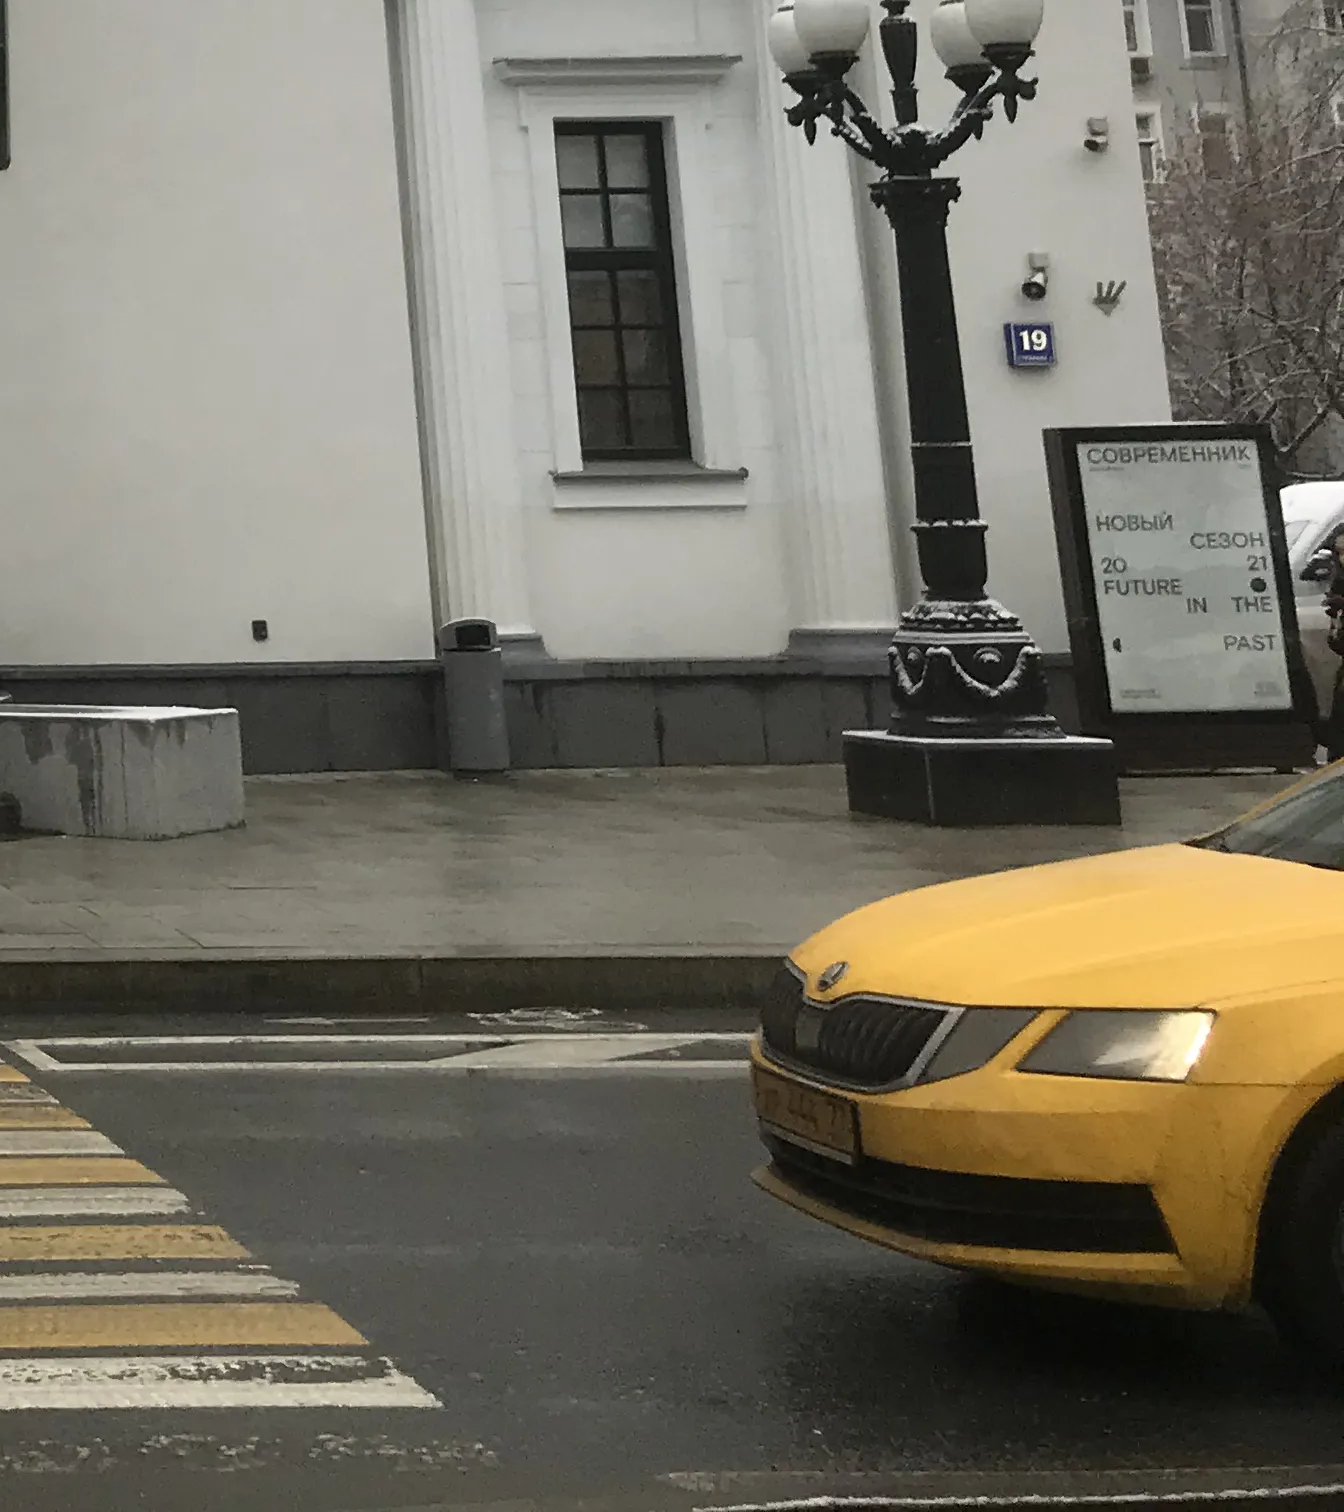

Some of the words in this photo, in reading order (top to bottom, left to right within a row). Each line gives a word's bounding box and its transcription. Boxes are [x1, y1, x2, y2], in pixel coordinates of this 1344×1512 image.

[1019, 329, 1047, 351] 19
[1086, 445, 1251, 465] СОВРЕМЕННИК
[1096, 510, 1174, 532] НОВЫЙ
[1189, 531, 1265, 550] СЕЗОН
[1100, 556, 1128, 574] 20
[1247, 555, 1267, 572] 21
[1103, 578, 1183, 596] FUTURE
[1186, 597, 1208, 614] IN
[1231, 595, 1273, 613] THE
[1223, 634, 1278, 652] PAST
